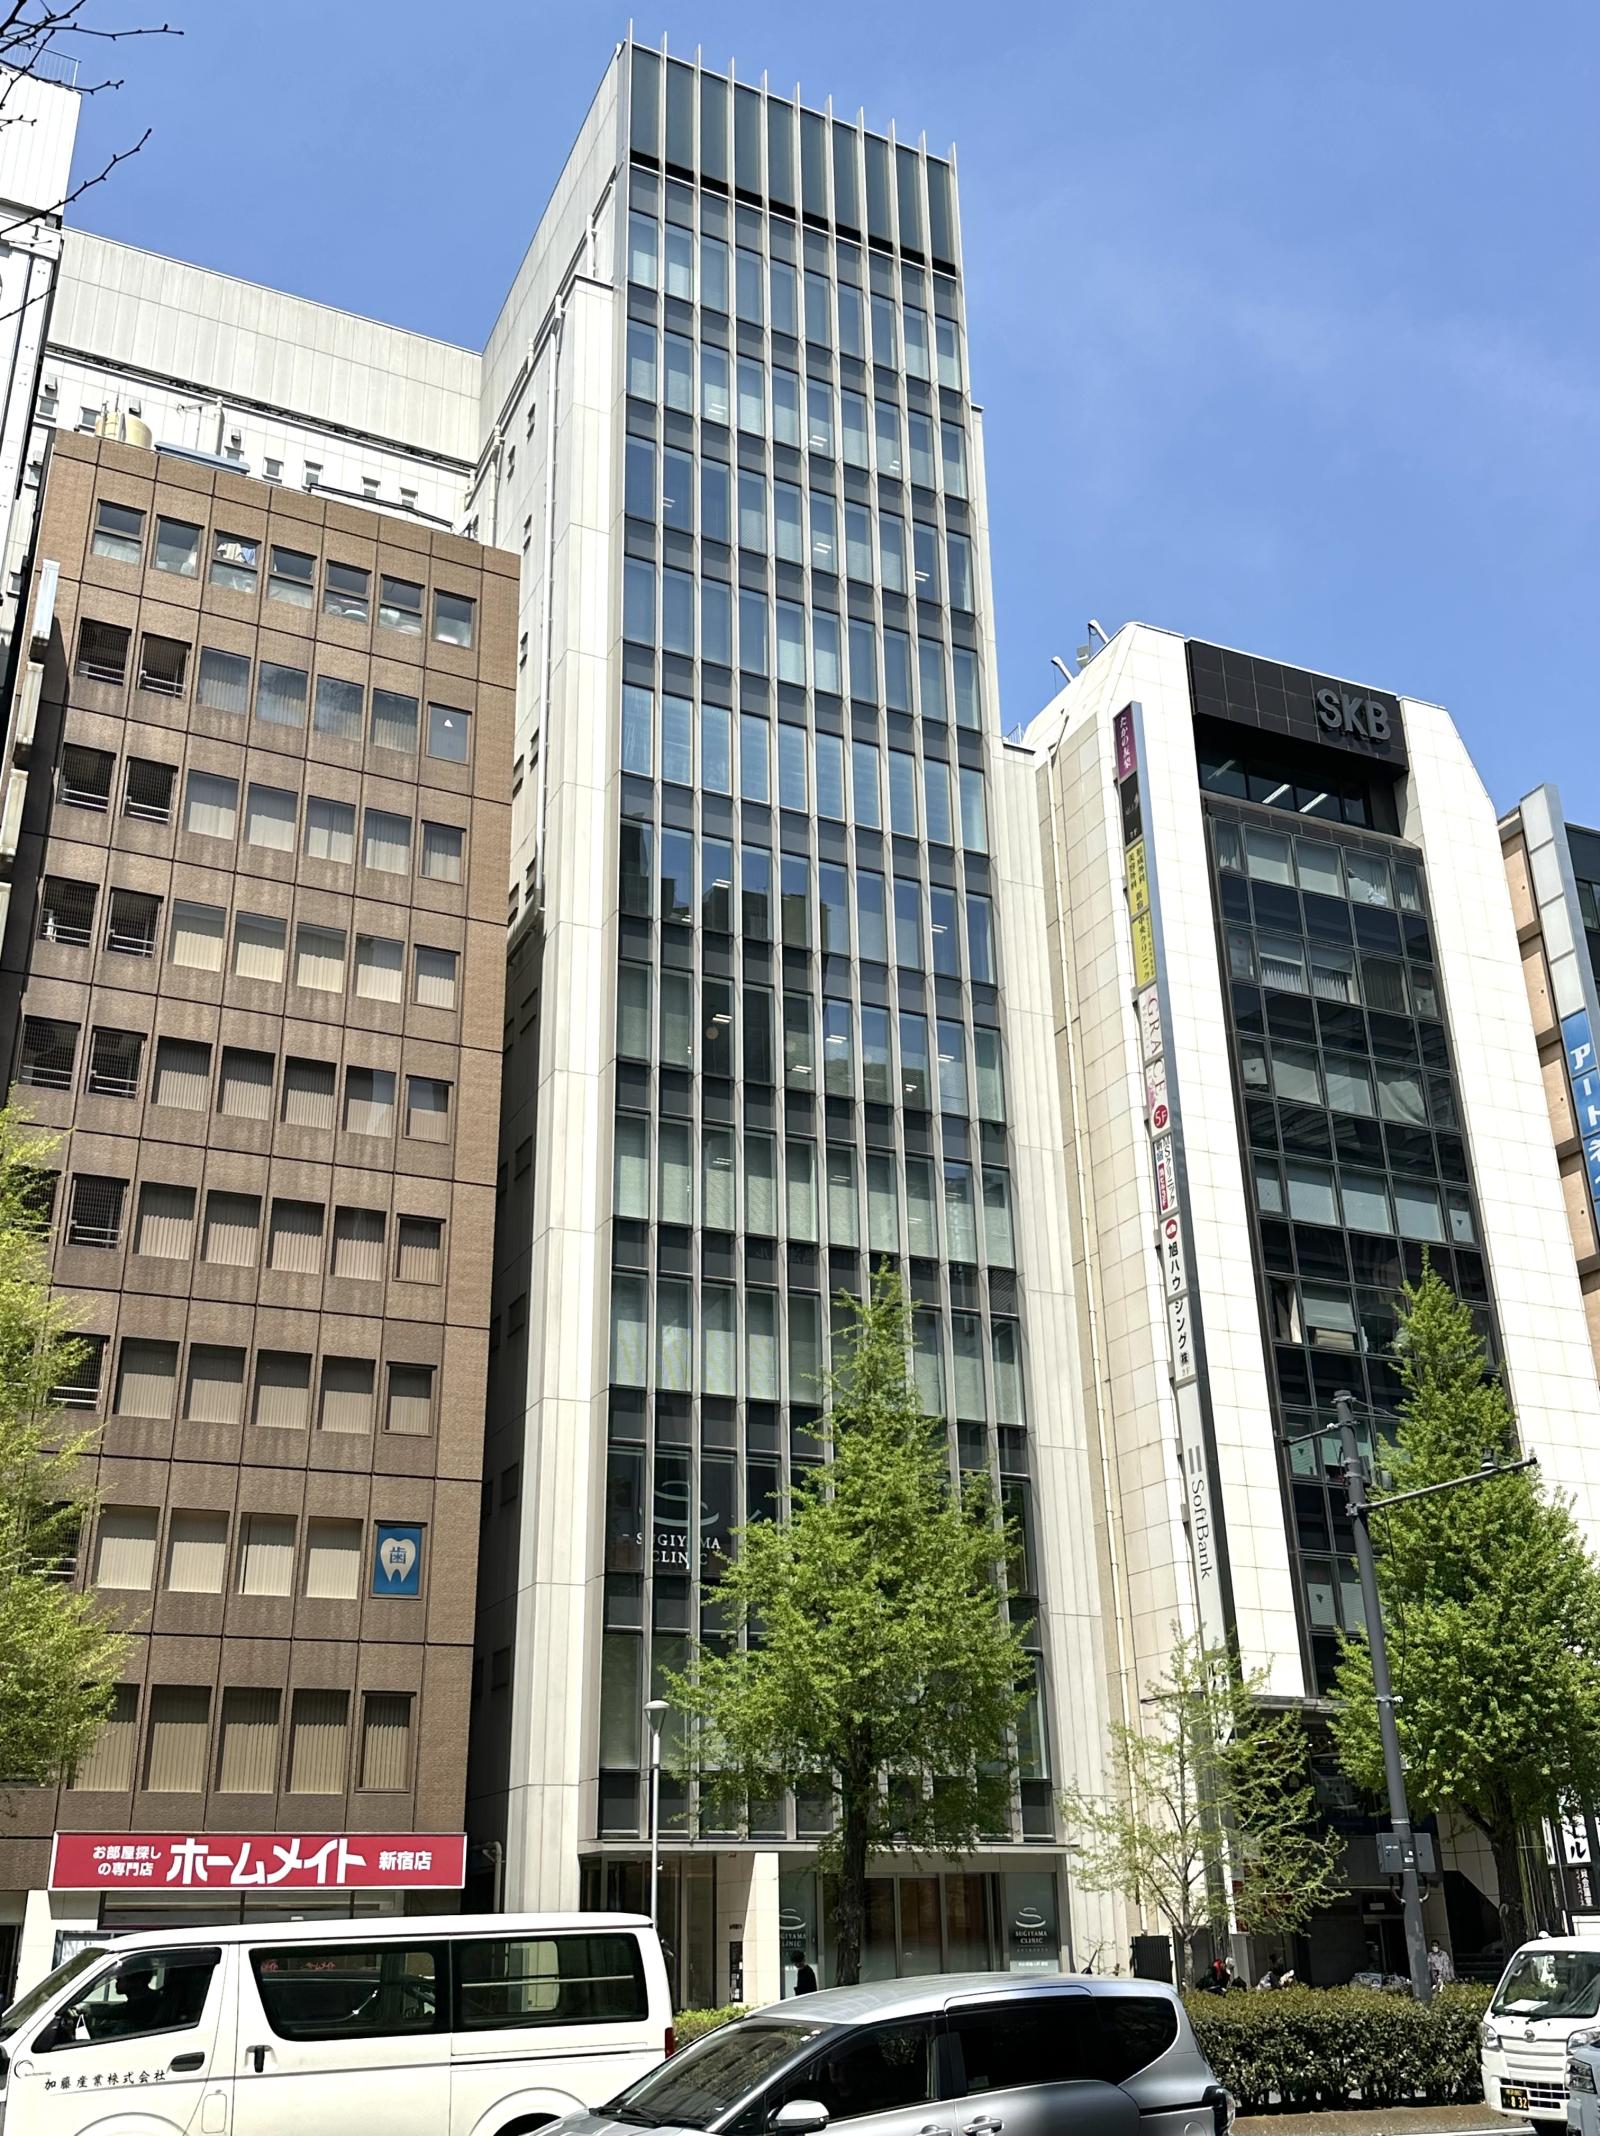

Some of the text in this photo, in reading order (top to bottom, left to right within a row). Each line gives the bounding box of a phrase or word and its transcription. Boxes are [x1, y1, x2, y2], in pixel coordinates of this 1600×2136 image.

[1316, 688, 1391, 741] SKB
[1147, 997, 1166, 1096] GRACE
[1154, 1109, 1167, 1126] 5F
[1191, 1478, 1213, 1580] SoftBank
[389, 1546, 407, 1564] 歯
[653, 1551, 708, 1565] CLINC
[93, 1845, 161, 1860] お部屋探し
[166, 1838, 367, 1885] ホームメイト
[378, 1850, 432, 1871] 新宿店
[97, 1861, 153, 1876] の専門店
[44, 2069, 166, 2091] 加藤産業株式会社
